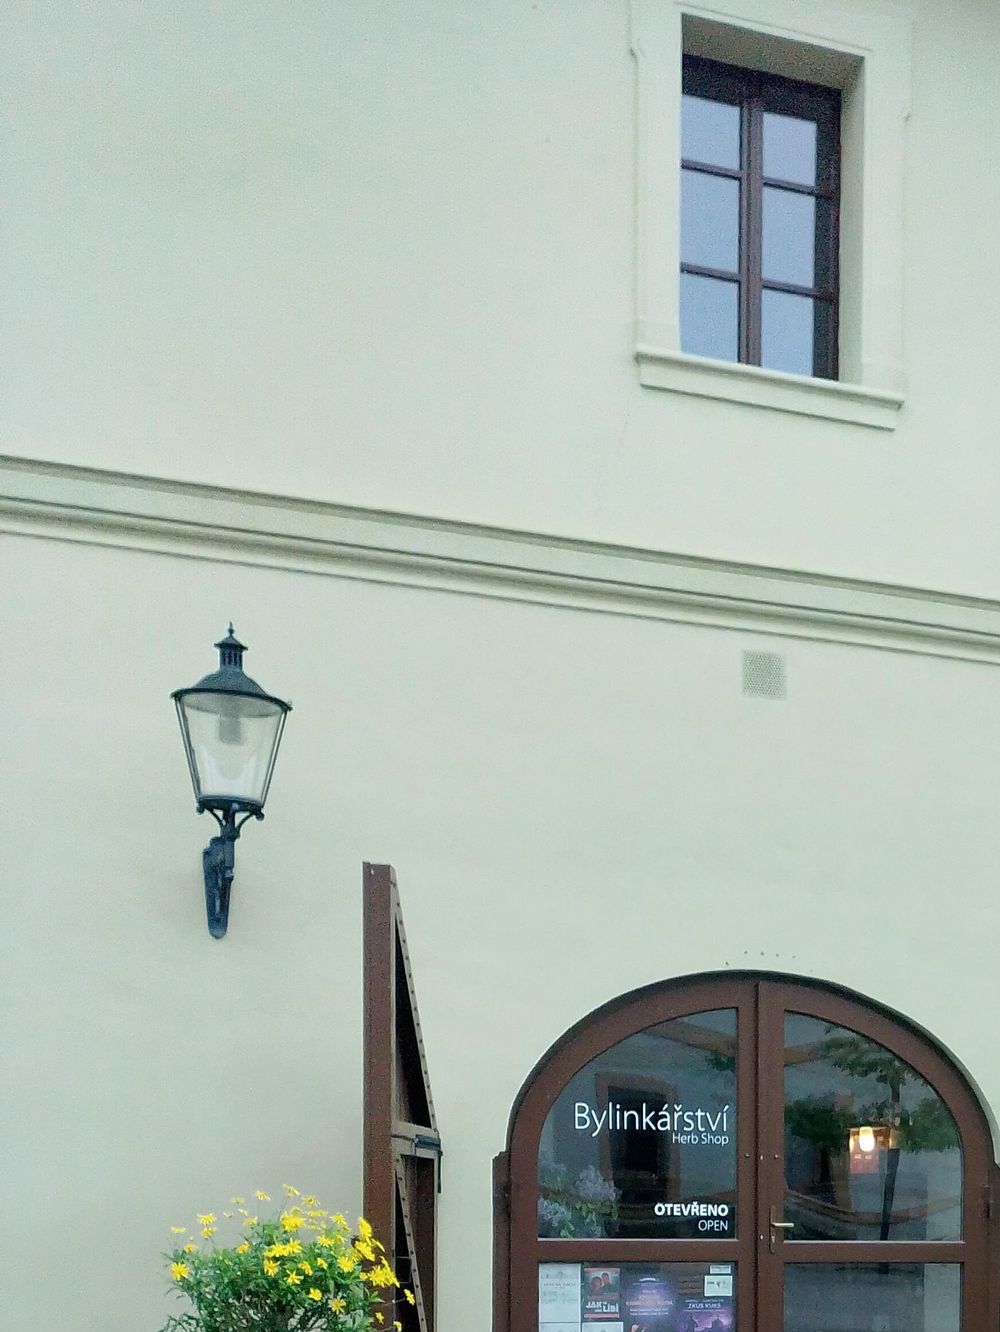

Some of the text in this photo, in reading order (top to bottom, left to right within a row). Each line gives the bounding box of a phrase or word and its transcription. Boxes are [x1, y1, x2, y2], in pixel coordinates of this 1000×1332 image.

[574, 1101, 729, 1137] Bylinkářství
[672, 1132, 729, 1147] Herb Shop
[654, 1201, 729, 1217] OTEVŘENO
[698, 1219, 729, 1231] OPEN
